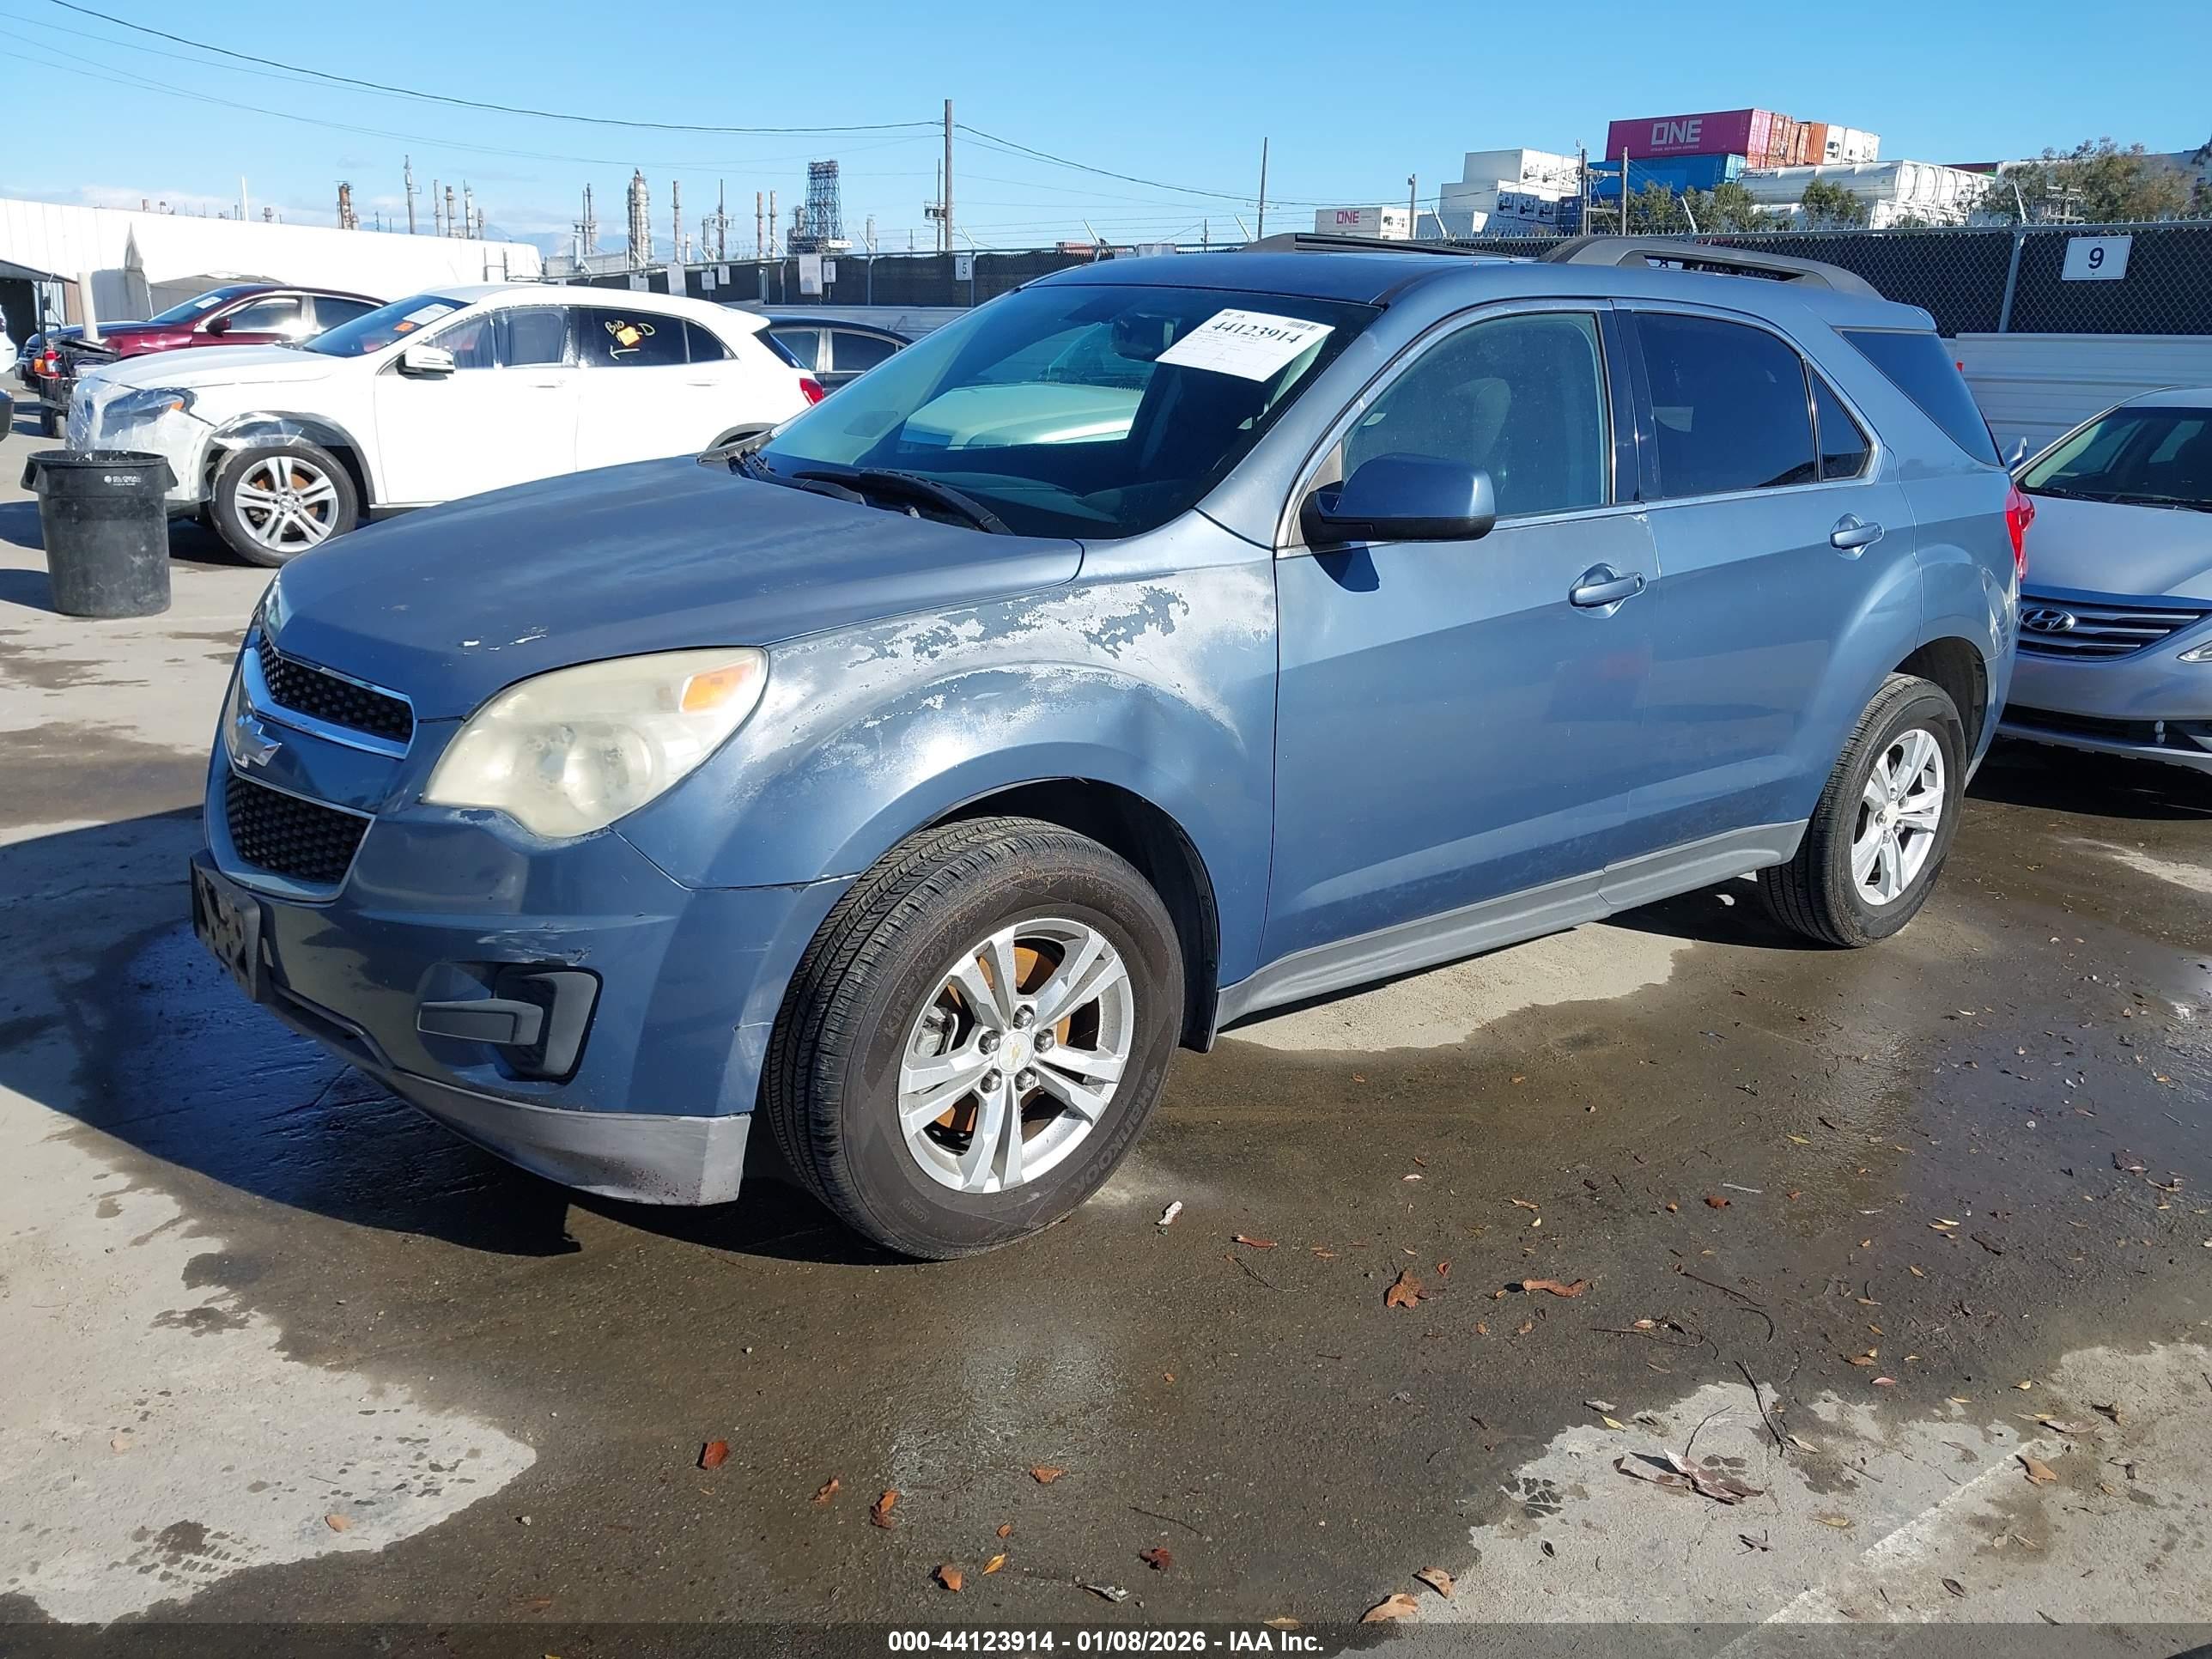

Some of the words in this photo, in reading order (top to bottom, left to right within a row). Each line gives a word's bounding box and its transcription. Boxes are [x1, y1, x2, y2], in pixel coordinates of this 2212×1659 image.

[1651, 119, 1703, 145] ONE
[1336, 210, 1360, 224] ONE
[2087, 247, 2105, 269] 9
[962, 262, 967, 275] 5
[605, 319, 625, 335] Bio
[1212, 321, 1304, 343] 44123914
